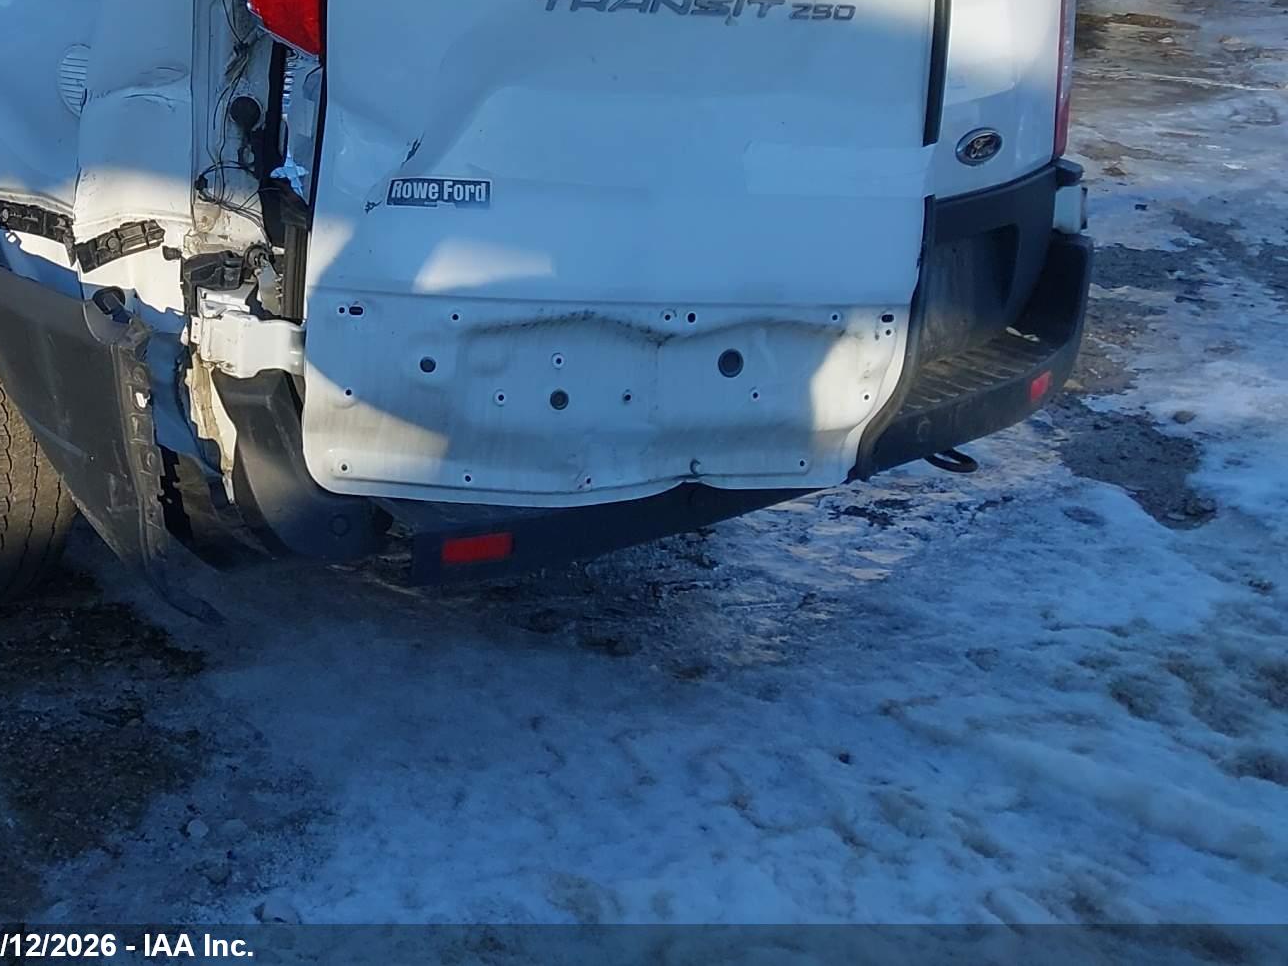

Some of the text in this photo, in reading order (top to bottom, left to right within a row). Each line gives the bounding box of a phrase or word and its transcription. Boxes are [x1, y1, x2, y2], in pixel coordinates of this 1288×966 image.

[789, 2, 856, 21] 250
[392, 180, 486, 202] Rowe Ford
